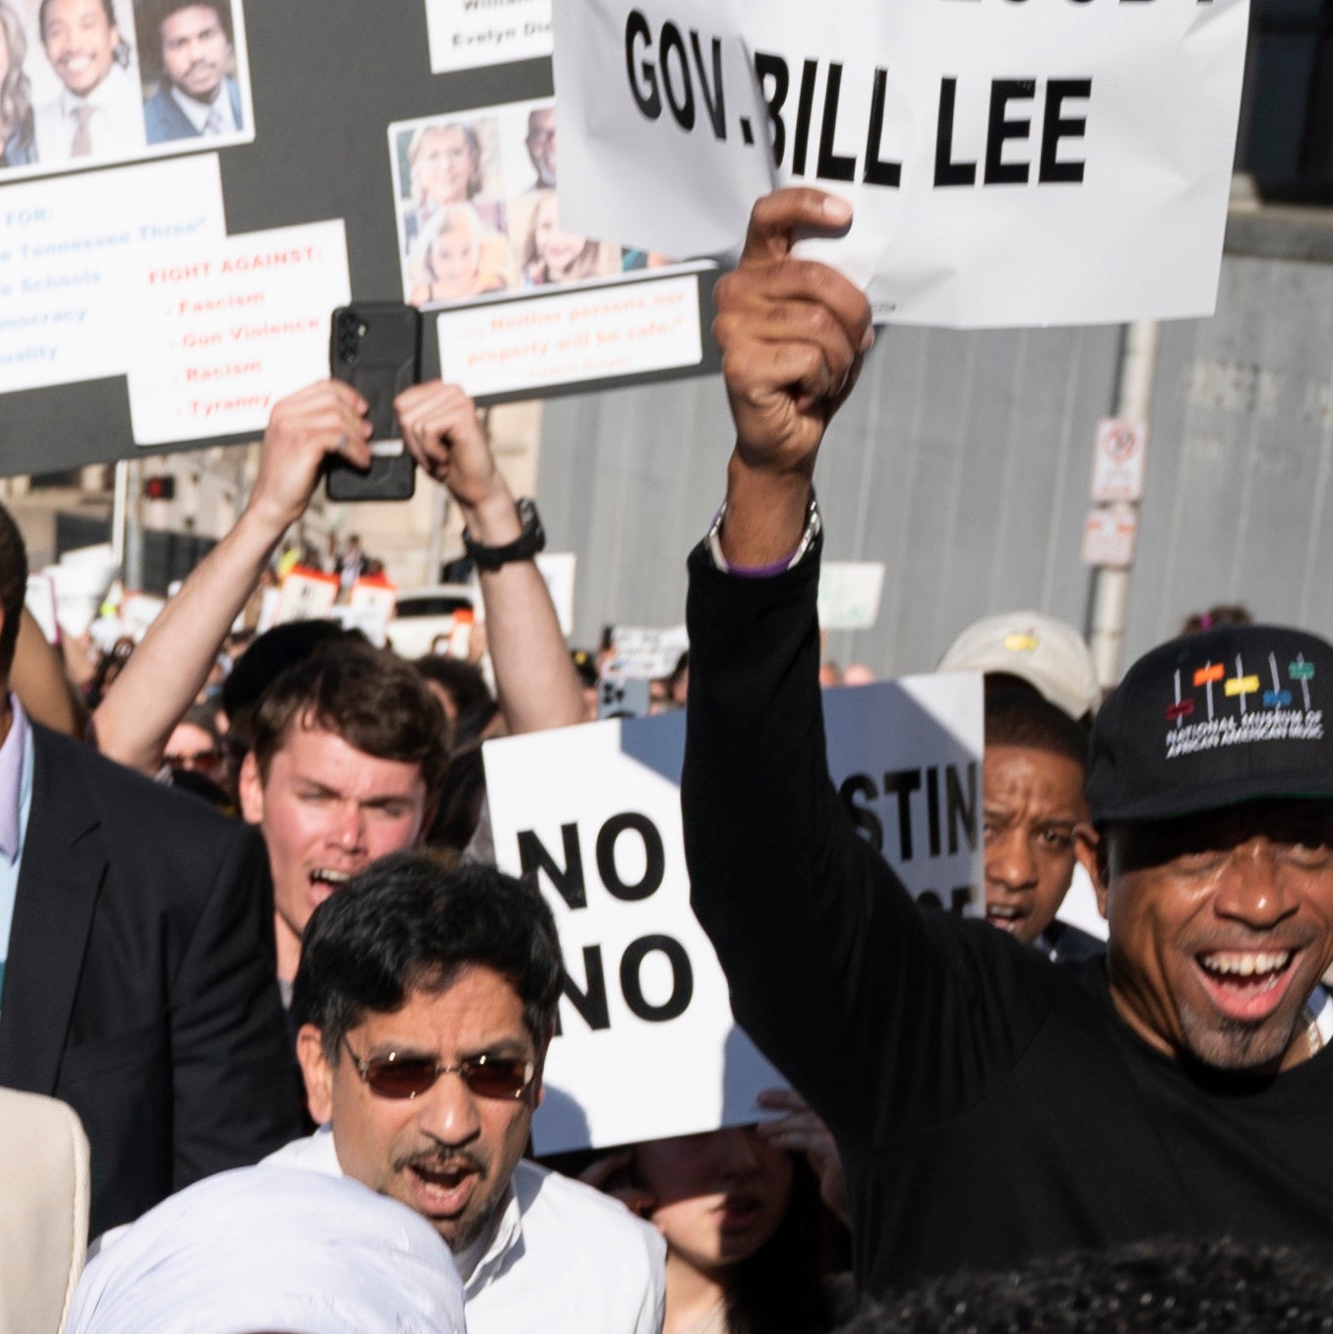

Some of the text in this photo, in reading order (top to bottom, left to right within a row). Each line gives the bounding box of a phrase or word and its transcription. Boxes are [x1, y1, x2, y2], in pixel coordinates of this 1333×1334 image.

[625, 9, 754, 146] GOV.
[933, 75, 1093, 188] LEE
[20, 231, 130, 258] Tennessee
[21, 270, 101, 294] Schools
[149, 263, 211, 285] FIGHT
[179, 292, 265, 315] Fascism
[183, 318, 319, 348] Gun Violence
[186, 361, 262, 381] Racism
[191, 392, 271, 416] Tyranny
[517, 812, 665, 911] NO
[552, 934, 694, 1037] NO
